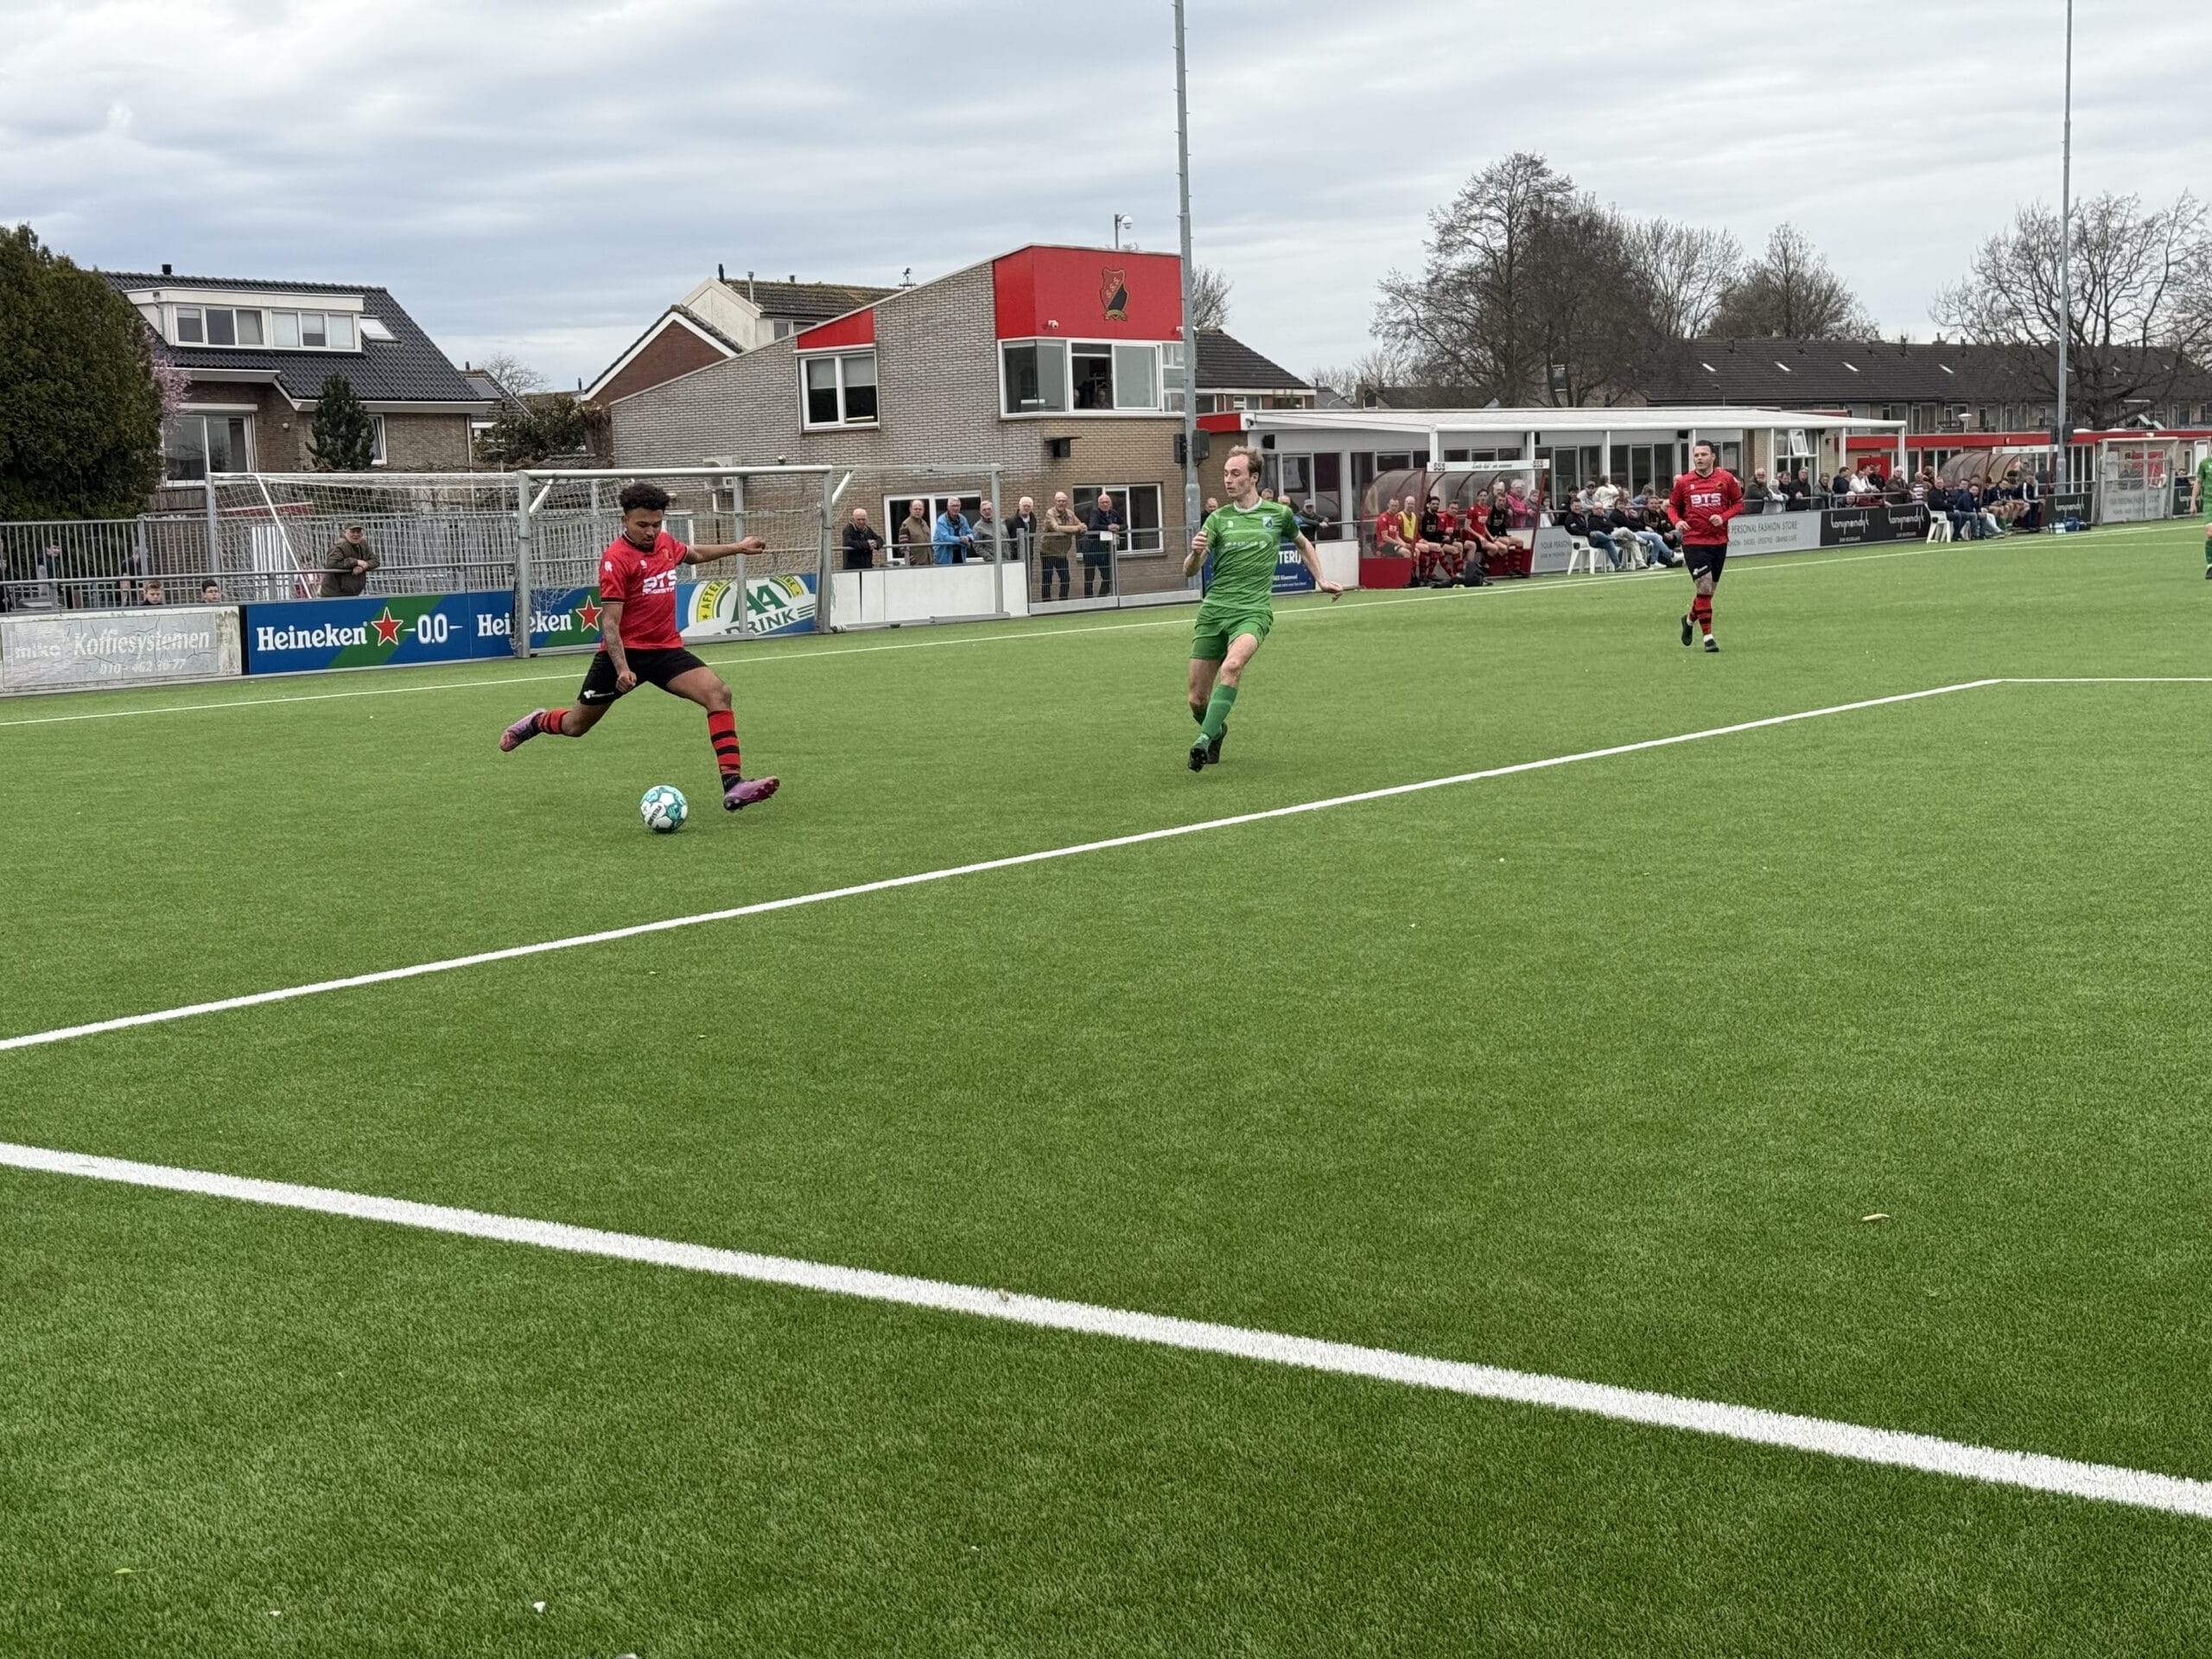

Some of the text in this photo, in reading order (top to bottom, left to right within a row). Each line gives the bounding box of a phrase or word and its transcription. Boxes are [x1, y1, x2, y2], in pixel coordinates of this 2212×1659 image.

[1689, 493, 1721, 505] BTS
[1758, 522, 1781, 532] FASHION
[257, 623, 367, 651] Heineken
[477, 610, 572, 637] Heieken
[74, 628, 210, 659] Koffiesystemen
